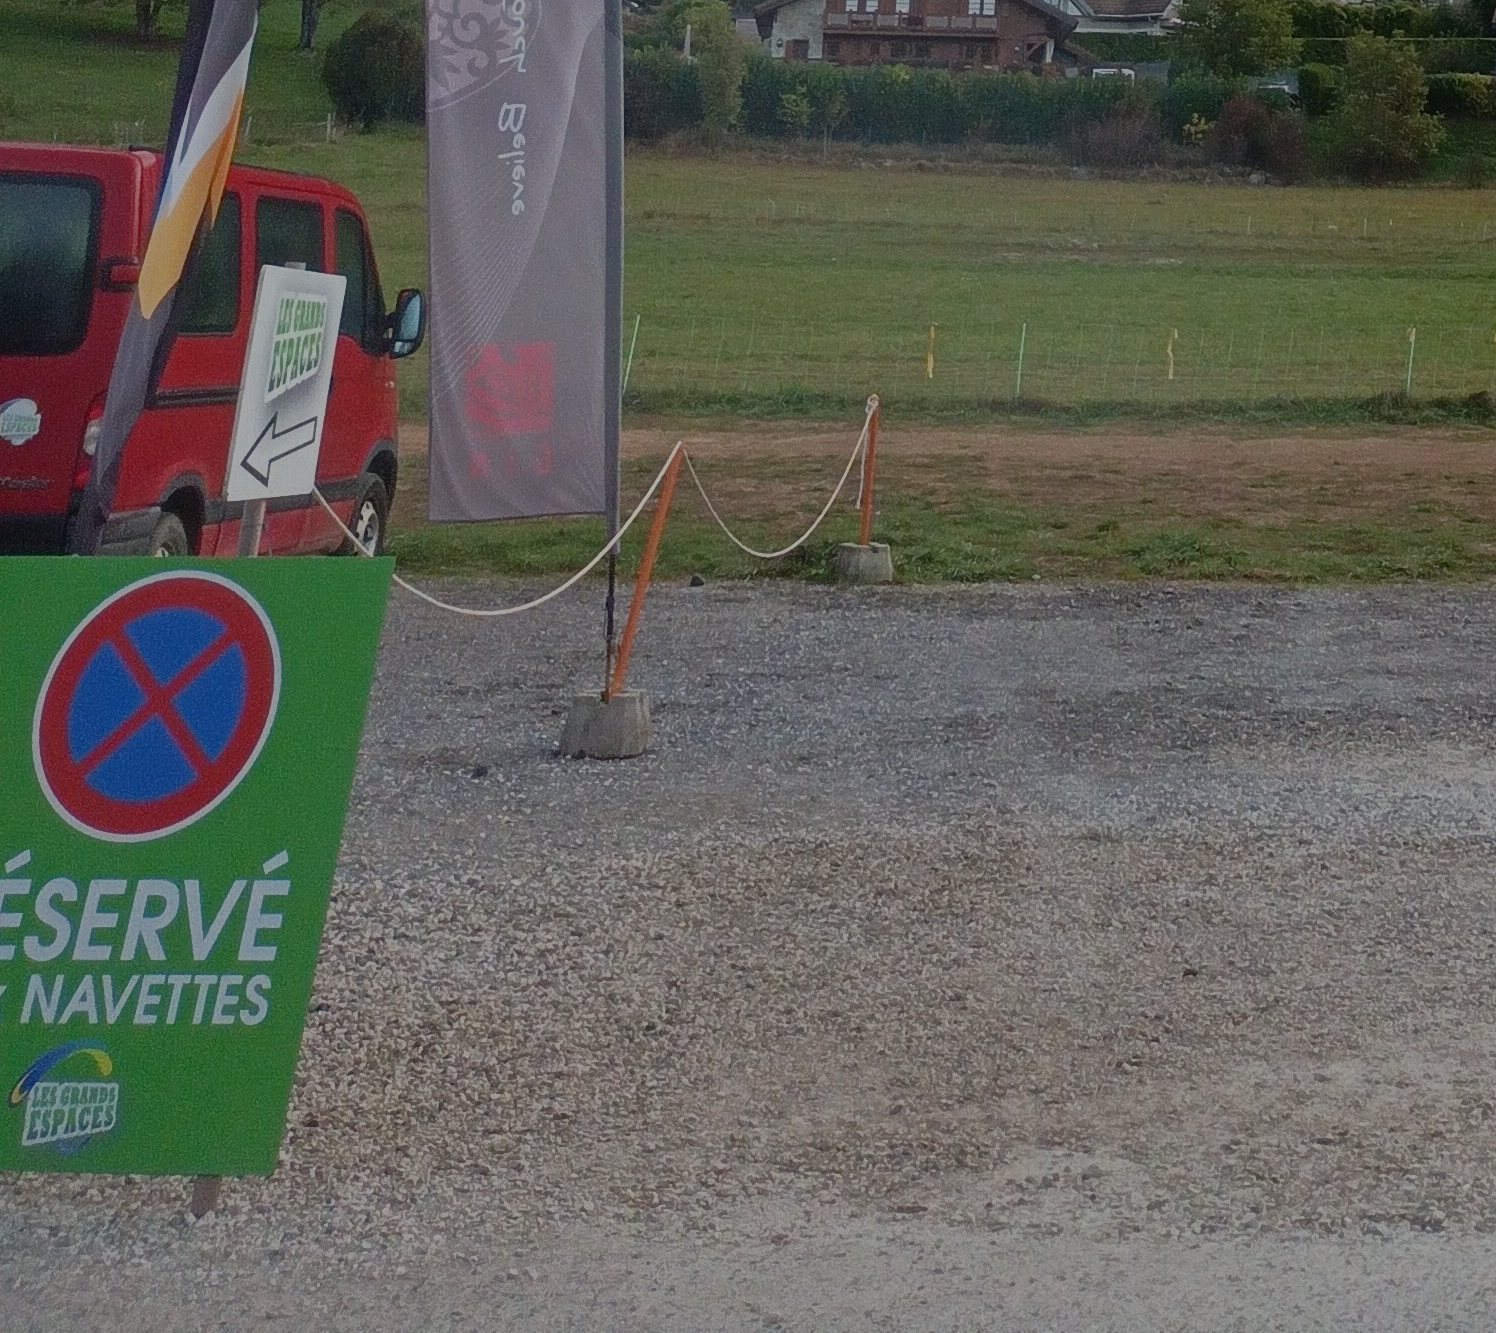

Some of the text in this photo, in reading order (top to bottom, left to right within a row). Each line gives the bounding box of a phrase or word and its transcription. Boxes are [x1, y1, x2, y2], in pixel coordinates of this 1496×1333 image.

[276, 298, 327, 335] LES GRANDS
[267, 331, 322, 394] ESPACES
[0, 849, 291, 962] ÉSERVÉ
[20, 974, 272, 1026] NAVETTES
[31, 1085, 117, 1108] LES GRANDS
[26, 1104, 114, 1142] ESPACES
